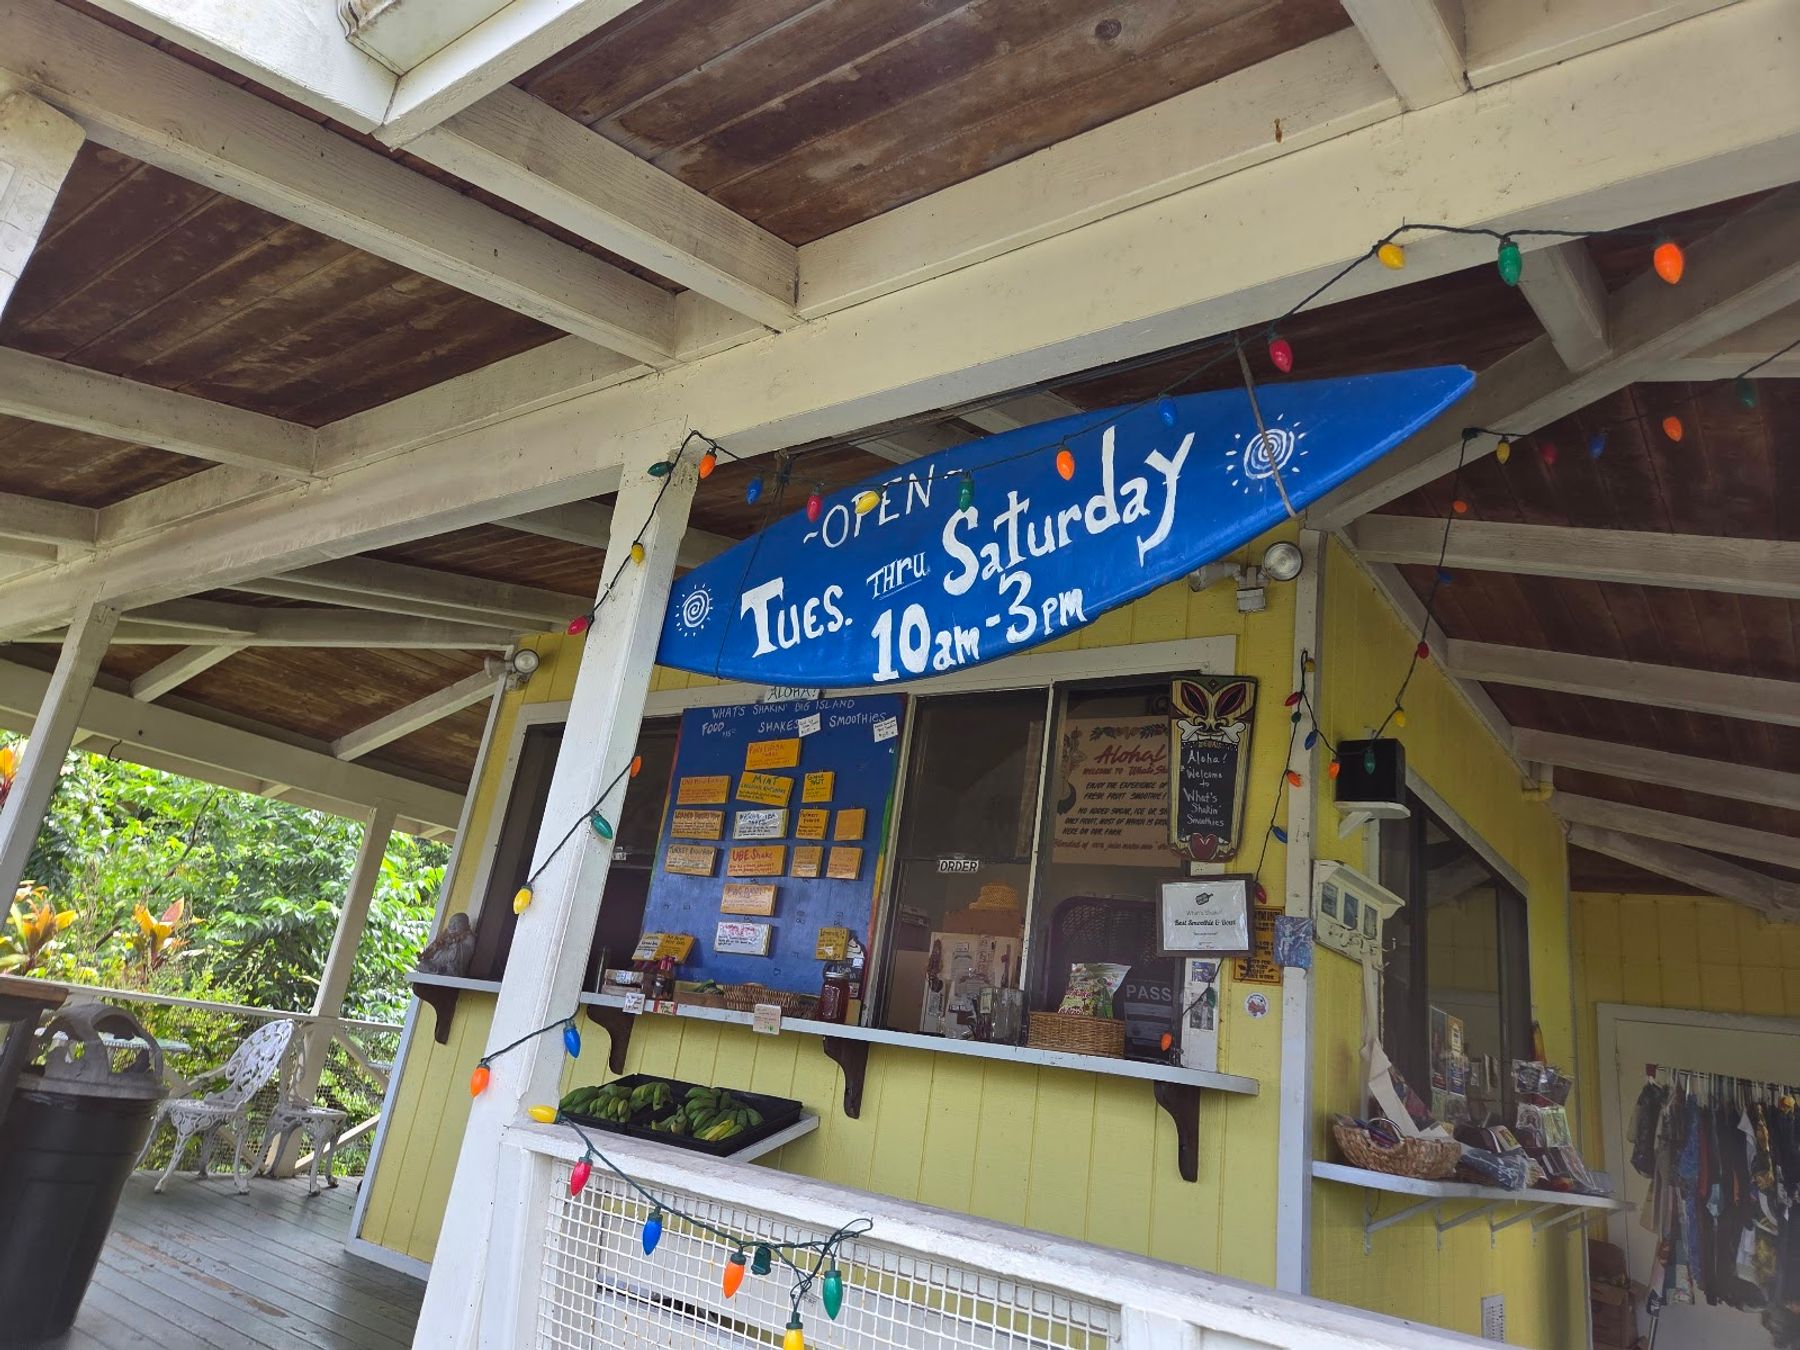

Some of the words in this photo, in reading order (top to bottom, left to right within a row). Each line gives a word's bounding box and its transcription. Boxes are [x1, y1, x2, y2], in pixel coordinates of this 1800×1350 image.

[942, 426, 1196, 596] Saturday
[795, 703, 811, 713] BIG
[815, 699, 856, 711] ISLAND
[701, 721, 725, 737] FOOD
[758, 719, 800, 734] SHAKES
[1094, 743, 1167, 766] Aloha!
[1187, 749, 1228, 764] Aloha!
[752, 774, 778, 786] MINT
[1186, 768, 1223, 779] Welcome
[1086, 781, 1106, 790] ENJOY
[1106, 781, 1119, 789] THE
[1119, 781, 1157, 789] EXPERIENCE
[1199, 779, 1210, 788] to
[1083, 792, 1105, 800] FRESH
[1106, 792, 1127, 800] FRUIT
[1183, 787, 1218, 802] What's
[1077, 807, 1088, 815] NO
[1089, 807, 1111, 815] ADDED
[1134, 807, 1146, 815] ICE
[1064, 817, 1079, 825] ONLY
[1098, 817, 1114, 825] MOST
[1115, 817, 1125, 825] OF
[1125, 817, 1145, 826] WHICH
[1145, 818, 1154, 826] IS
[1186, 813, 1225, 827] Smoothies
[1104, 828, 1122, 836] FARM
[732, 849, 751, 862] UBE
[939, 860, 978, 872] ORDER
[1125, 984, 1172, 1002] PASS
